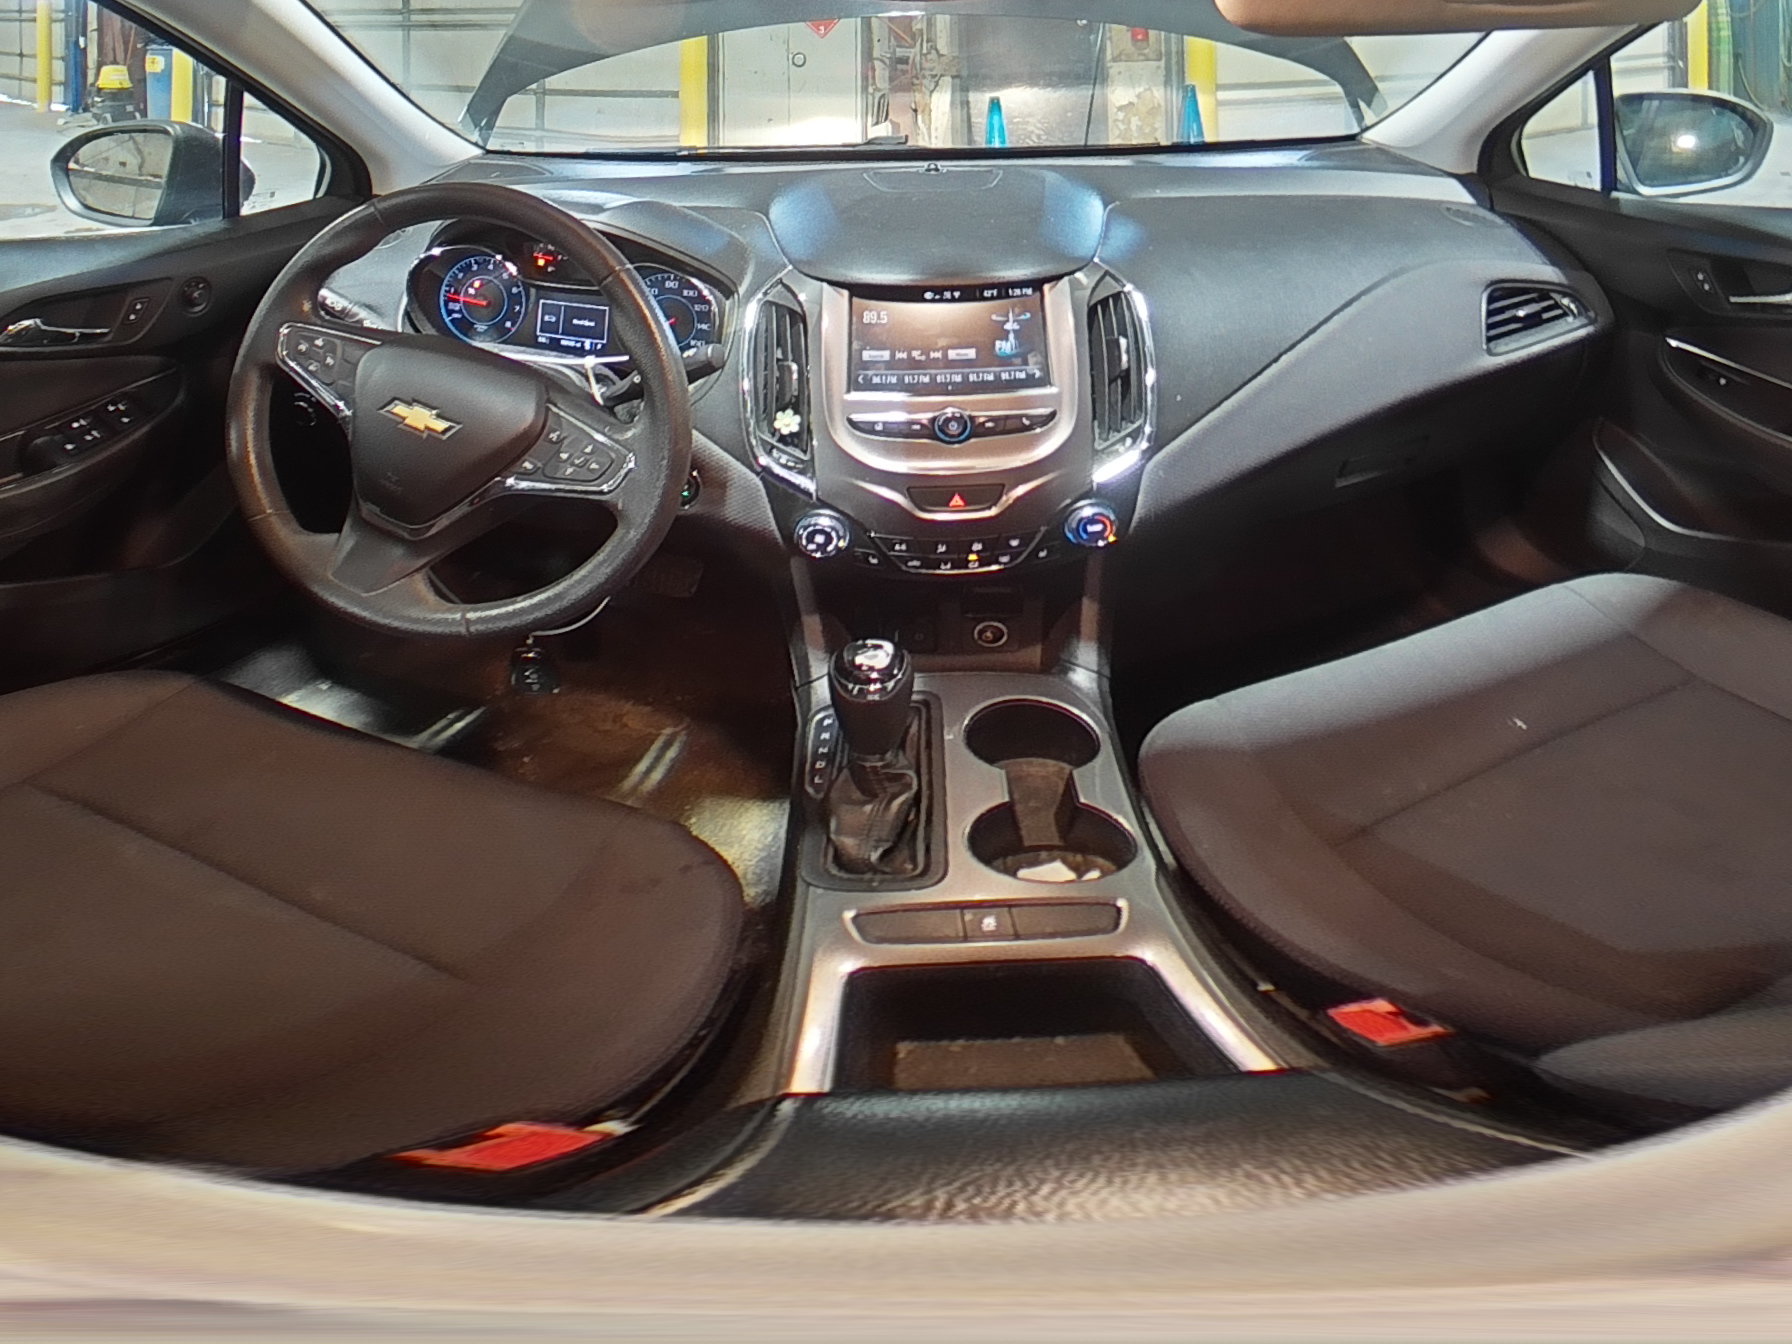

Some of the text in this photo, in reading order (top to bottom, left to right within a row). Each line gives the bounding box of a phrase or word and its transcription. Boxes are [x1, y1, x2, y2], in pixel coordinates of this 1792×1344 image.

[682, 289, 698, 297] 100
[694, 304, 709, 312] 120
[863, 310, 888, 324] 89.5
